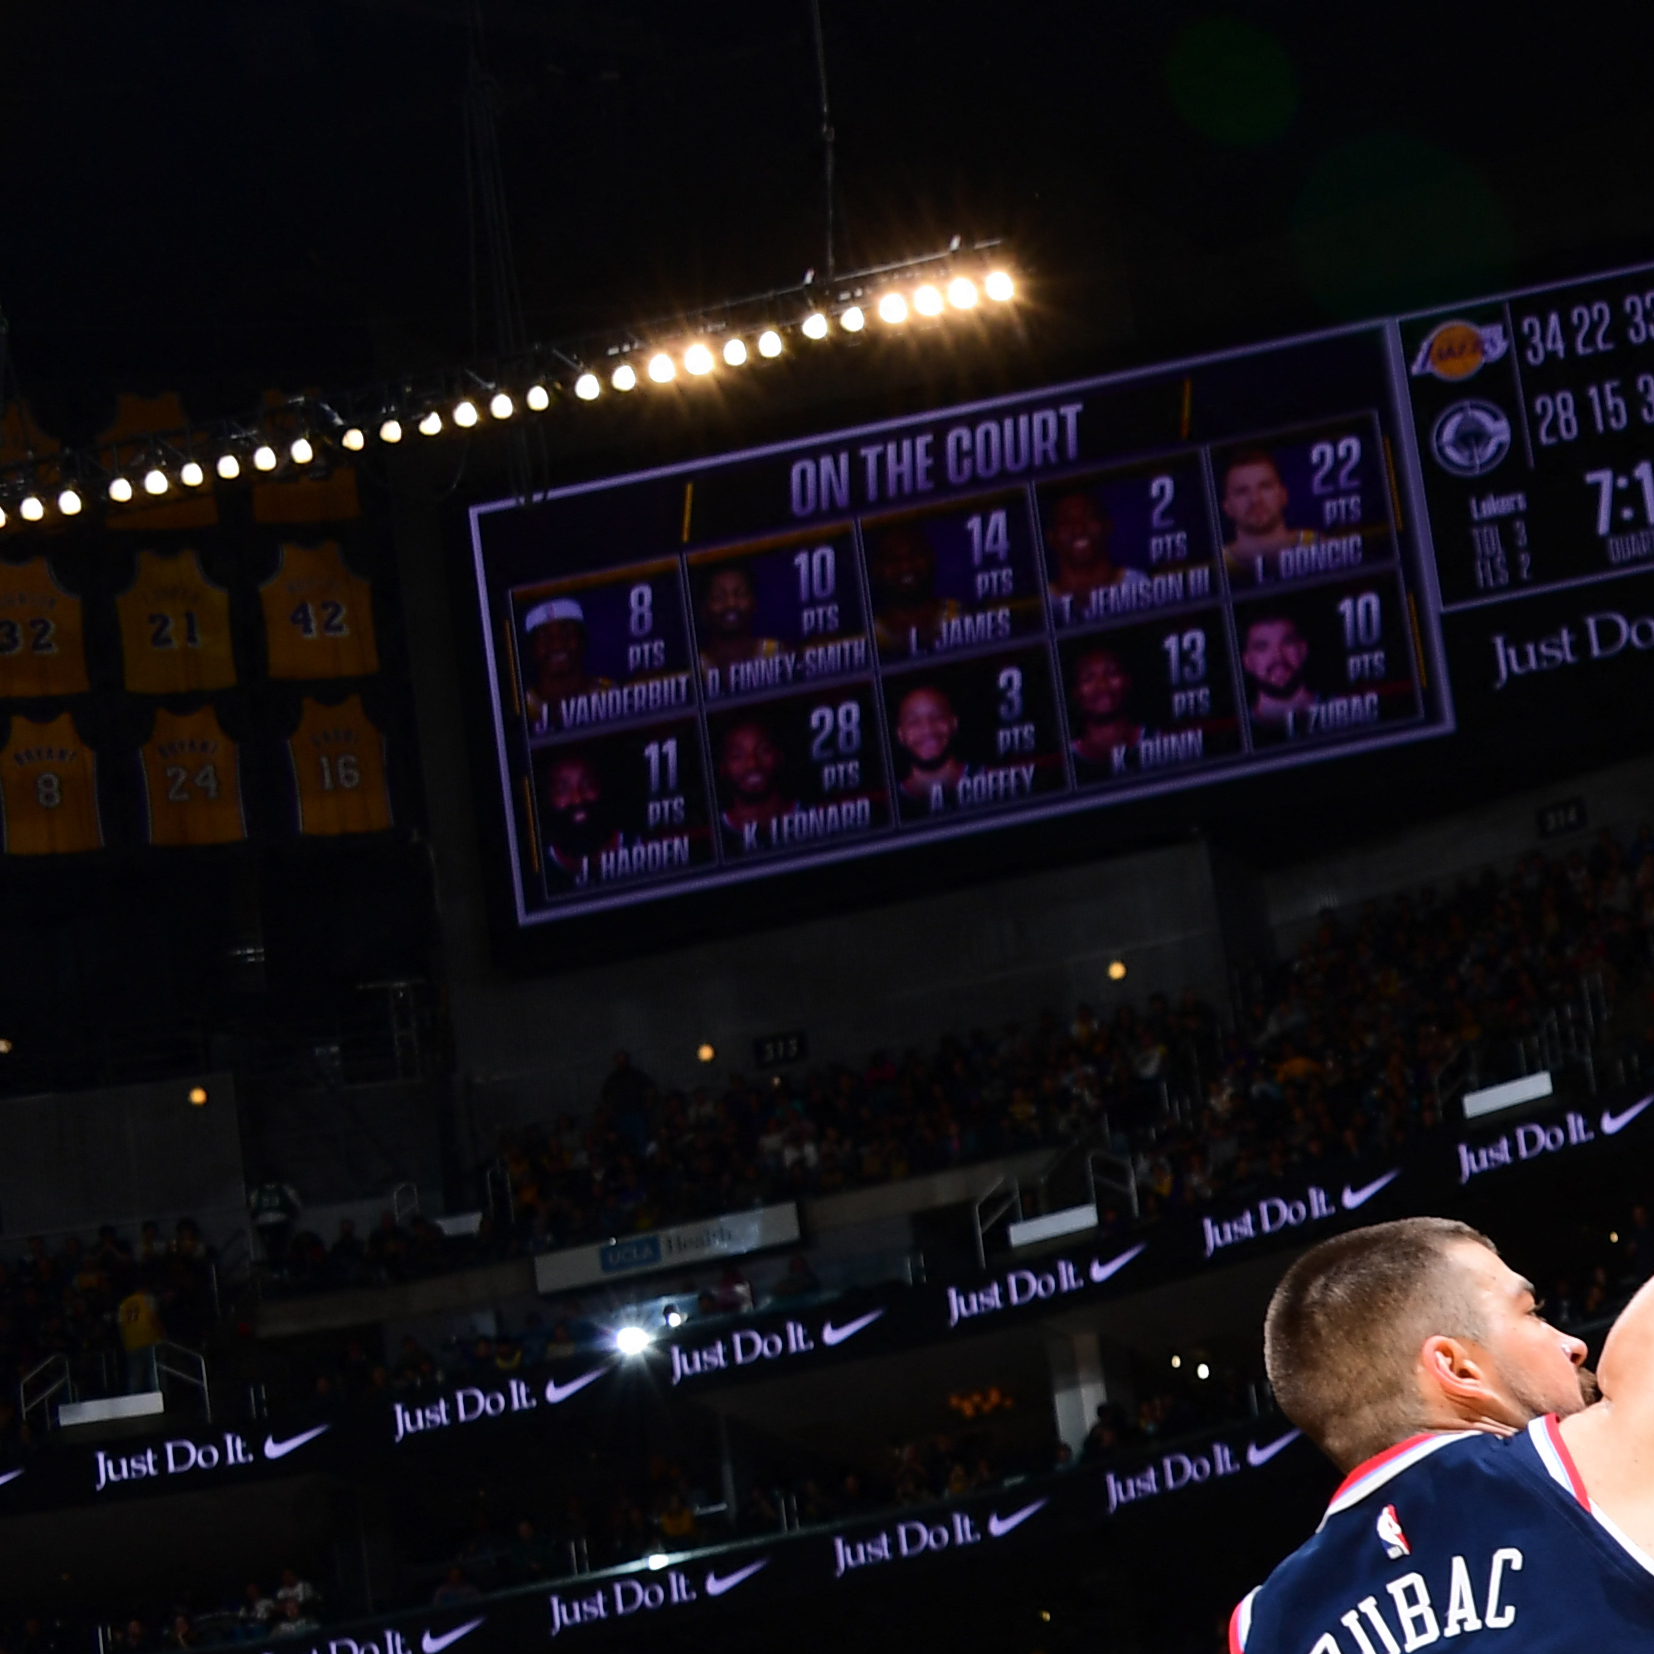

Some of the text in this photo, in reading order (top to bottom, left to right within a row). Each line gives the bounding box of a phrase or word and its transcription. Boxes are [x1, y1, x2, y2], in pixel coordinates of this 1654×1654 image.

[1522, 313, 1565, 367] 34
[1572, 301, 1615, 356] 22
[1535, 389, 1578, 446] 28
[1588, 379, 1627, 434] 15
[791, 403, 1084, 517] ON THE COURT
[1311, 437, 1362, 495] 22
[1150, 475, 1175, 529] 2
[966, 508, 1010, 566] 14
[794, 543, 837, 604] 10
[148, 611, 201, 651] 21
[290, 601, 350, 640] 42
[628, 582, 654, 638] 8
[1338, 590, 1381, 649] 10
[1163, 628, 1207, 685] 13
[1490, 626, 1578, 691] Just
[997, 665, 1023, 721] 3
[810, 701, 862, 760] 28
[34, 770, 61, 808] 8
[166, 764, 221, 804] 24
[319, 754, 360, 793] 16
[645, 738, 680, 792] 11
[1459, 1113, 1594, 1183] Just Do It.
[1204, 1188, 1335, 1256] Just Do It.
[671, 1322, 813, 1384] Just Do It.
[97, 1434, 253, 1490] Just Do It.
[1107, 1444, 1240, 1512] Just Do It.
[835, 1514, 980, 1576] Just Do It.
